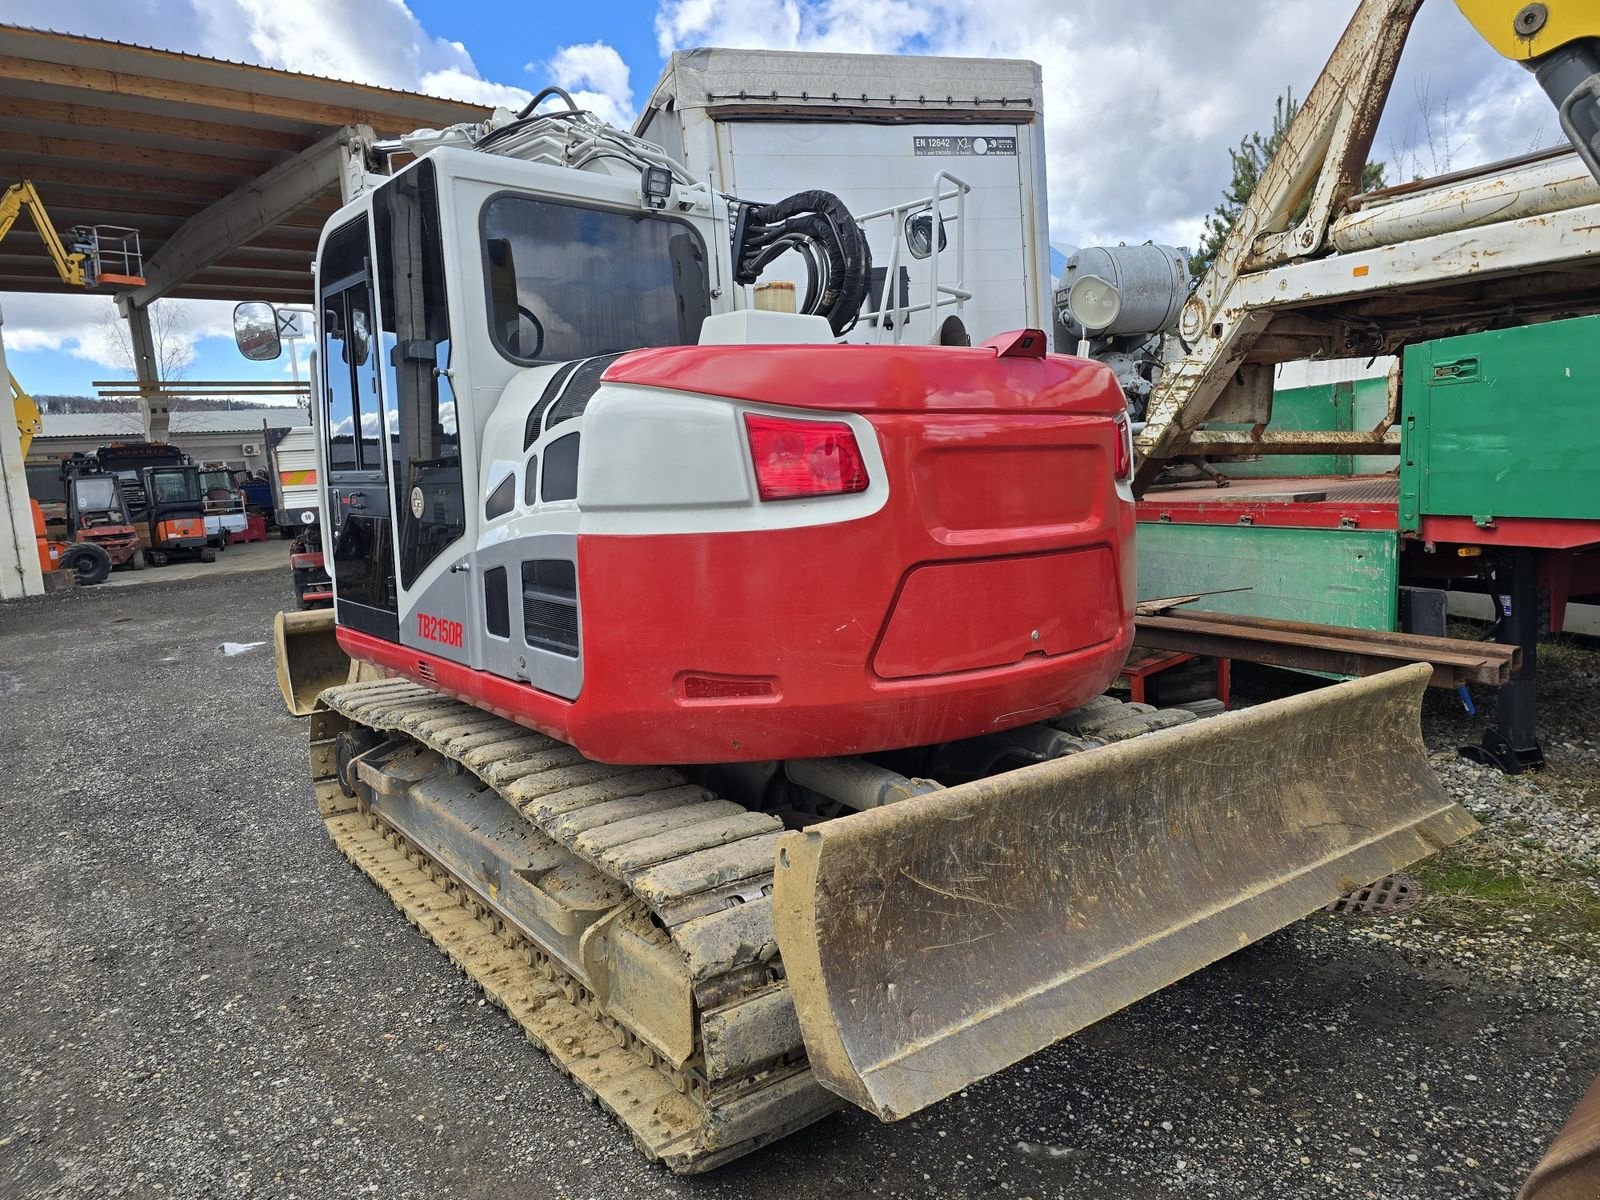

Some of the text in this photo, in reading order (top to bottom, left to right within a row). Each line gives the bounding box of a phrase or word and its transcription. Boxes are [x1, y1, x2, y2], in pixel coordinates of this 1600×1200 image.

[916, 138, 926, 147] EN
[928, 138, 950, 147] 12642
[116, 448, 165, 456] AUSTRIA
[417, 612, 463, 649] TB2150R
